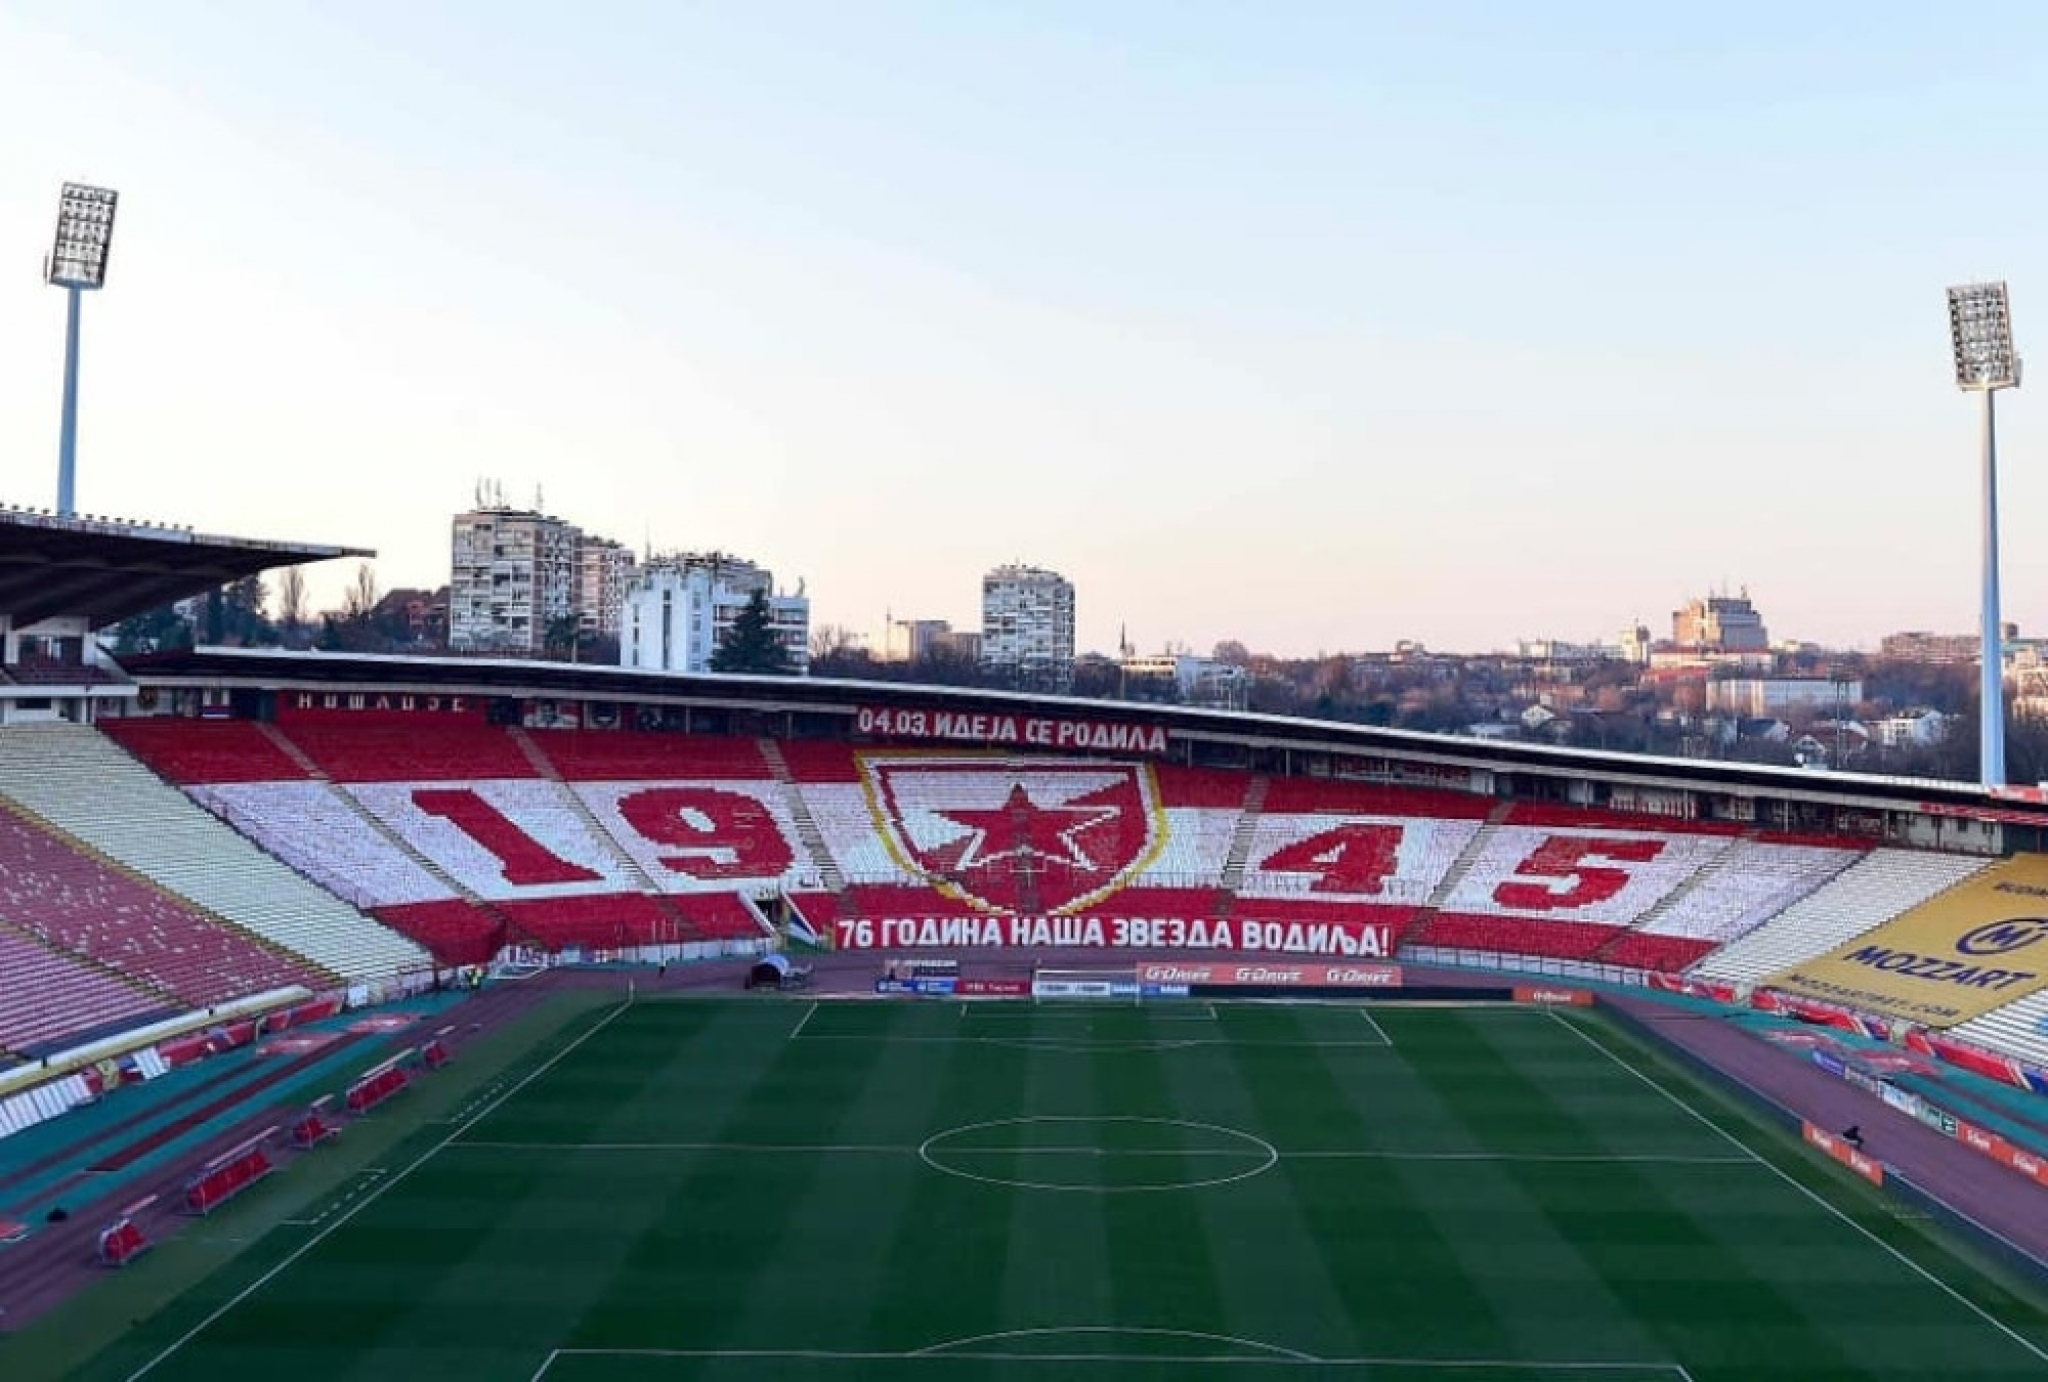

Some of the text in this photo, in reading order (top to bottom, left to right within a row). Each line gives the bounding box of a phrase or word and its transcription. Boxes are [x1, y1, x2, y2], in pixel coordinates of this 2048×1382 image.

[857, 708, 1167, 752] 04.03. ИДЕЈА СЕ РОДИЛА
[837, 917, 1391, 957] 76 ГОДИНА НАША ЗВЕЗДА ВОДИЉА!
[1842, 945, 2037, 991] MOZZART
